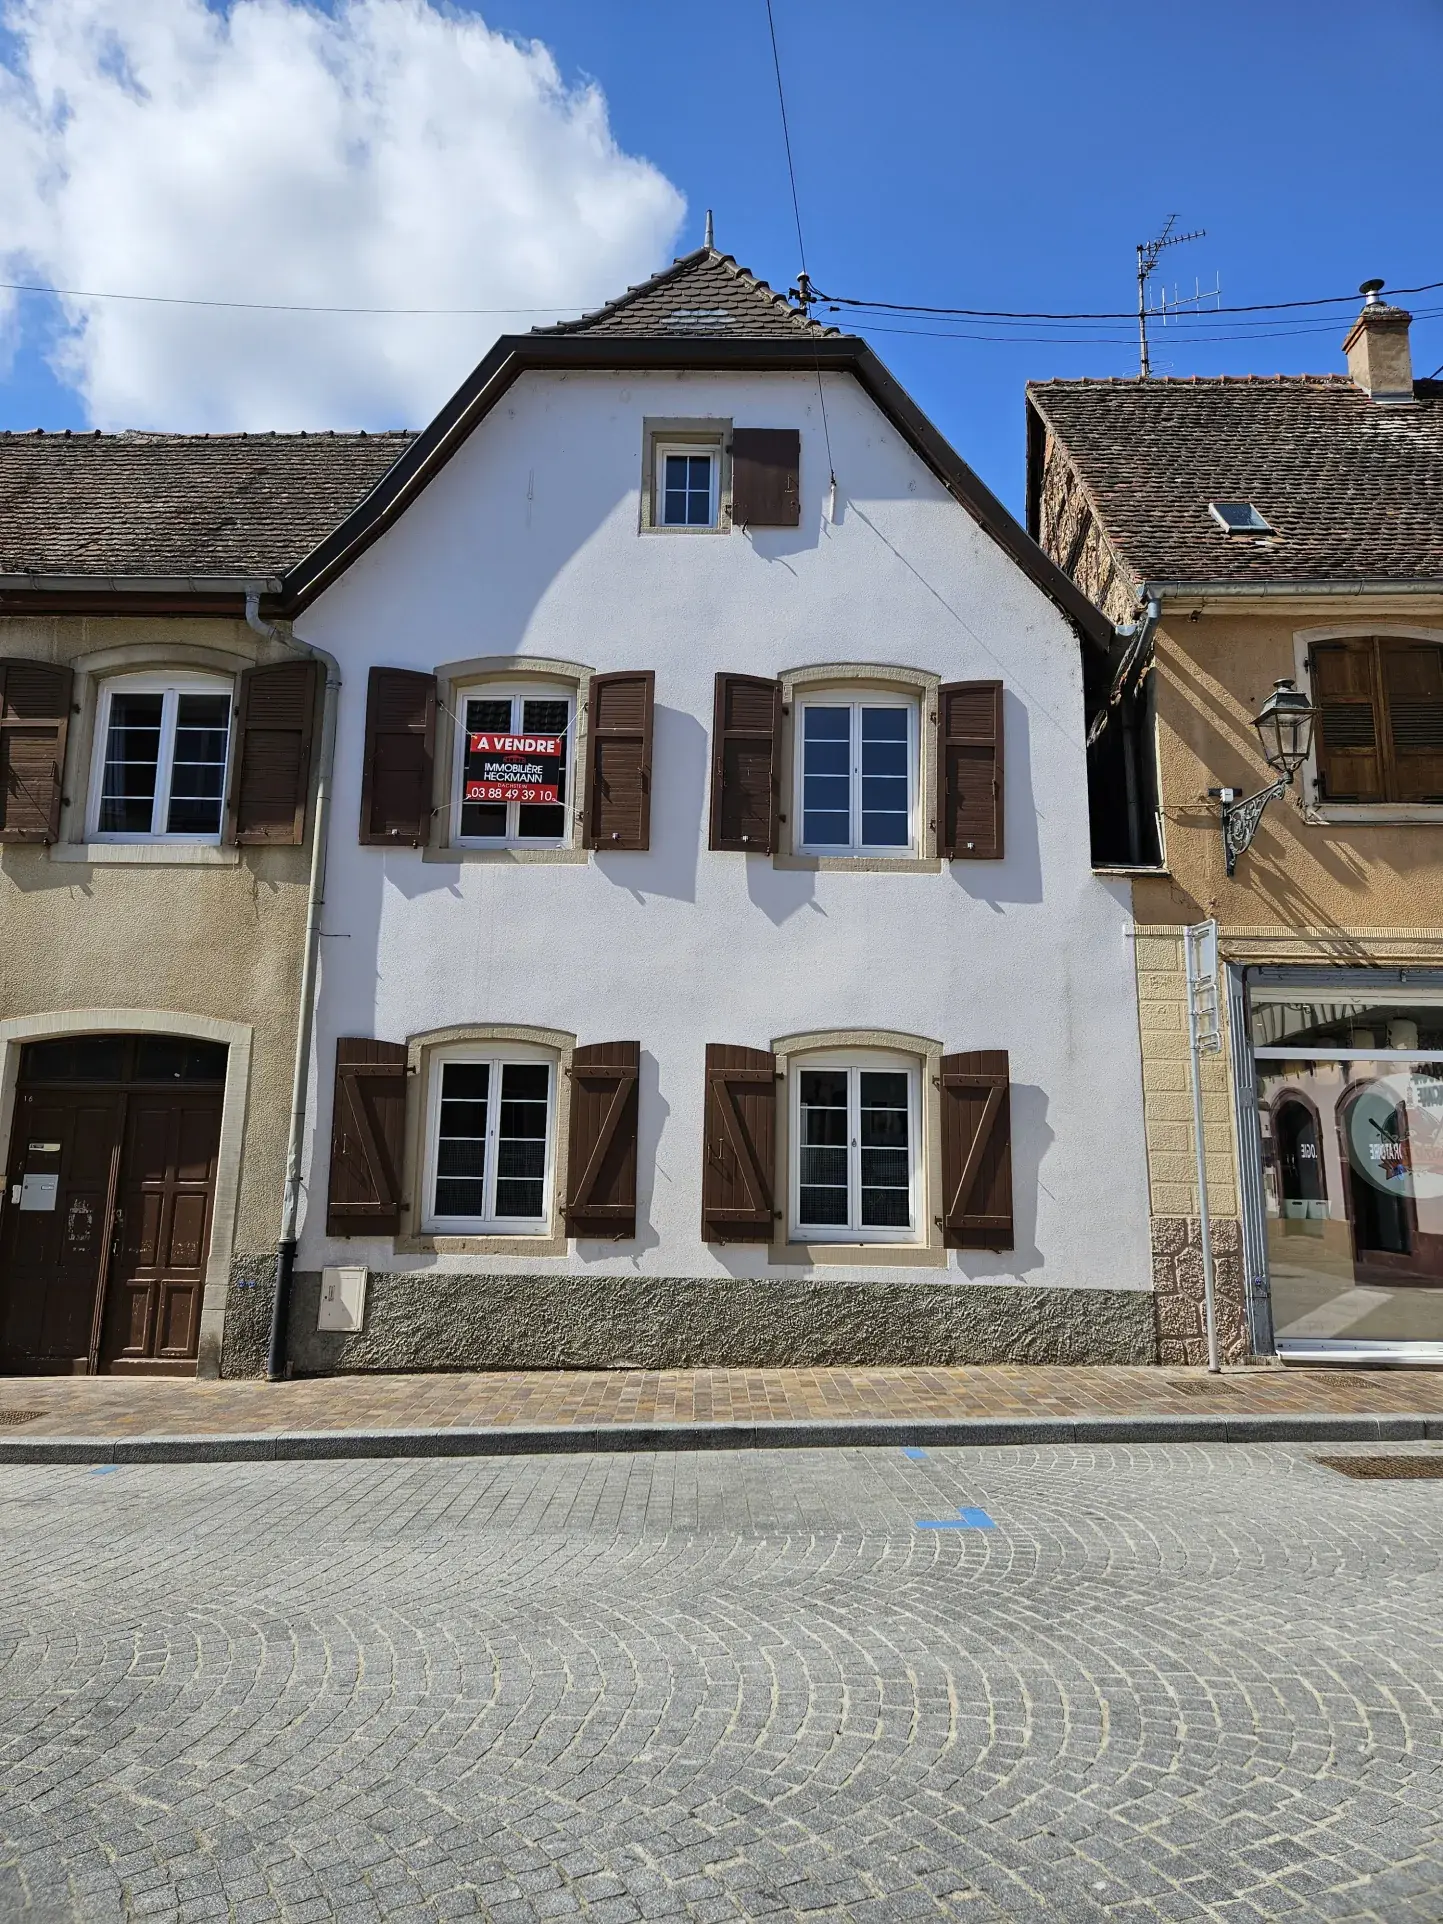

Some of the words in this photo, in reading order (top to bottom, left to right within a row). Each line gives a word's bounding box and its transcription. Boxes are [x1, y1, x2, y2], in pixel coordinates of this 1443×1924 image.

[477, 736, 489, 749] A
[493, 737, 555, 752] VENDRE
[484, 763, 543, 774] IMMOBILIÈRE
[483, 772, 543, 783] HECKMANN
[471, 787, 485, 798] 03
[488, 788, 502, 799] 88
[504, 789, 519, 800] 49
[521, 789, 536, 801] 39
[539, 790, 552, 801] 10
[24, 1095, 33, 1103] 16
